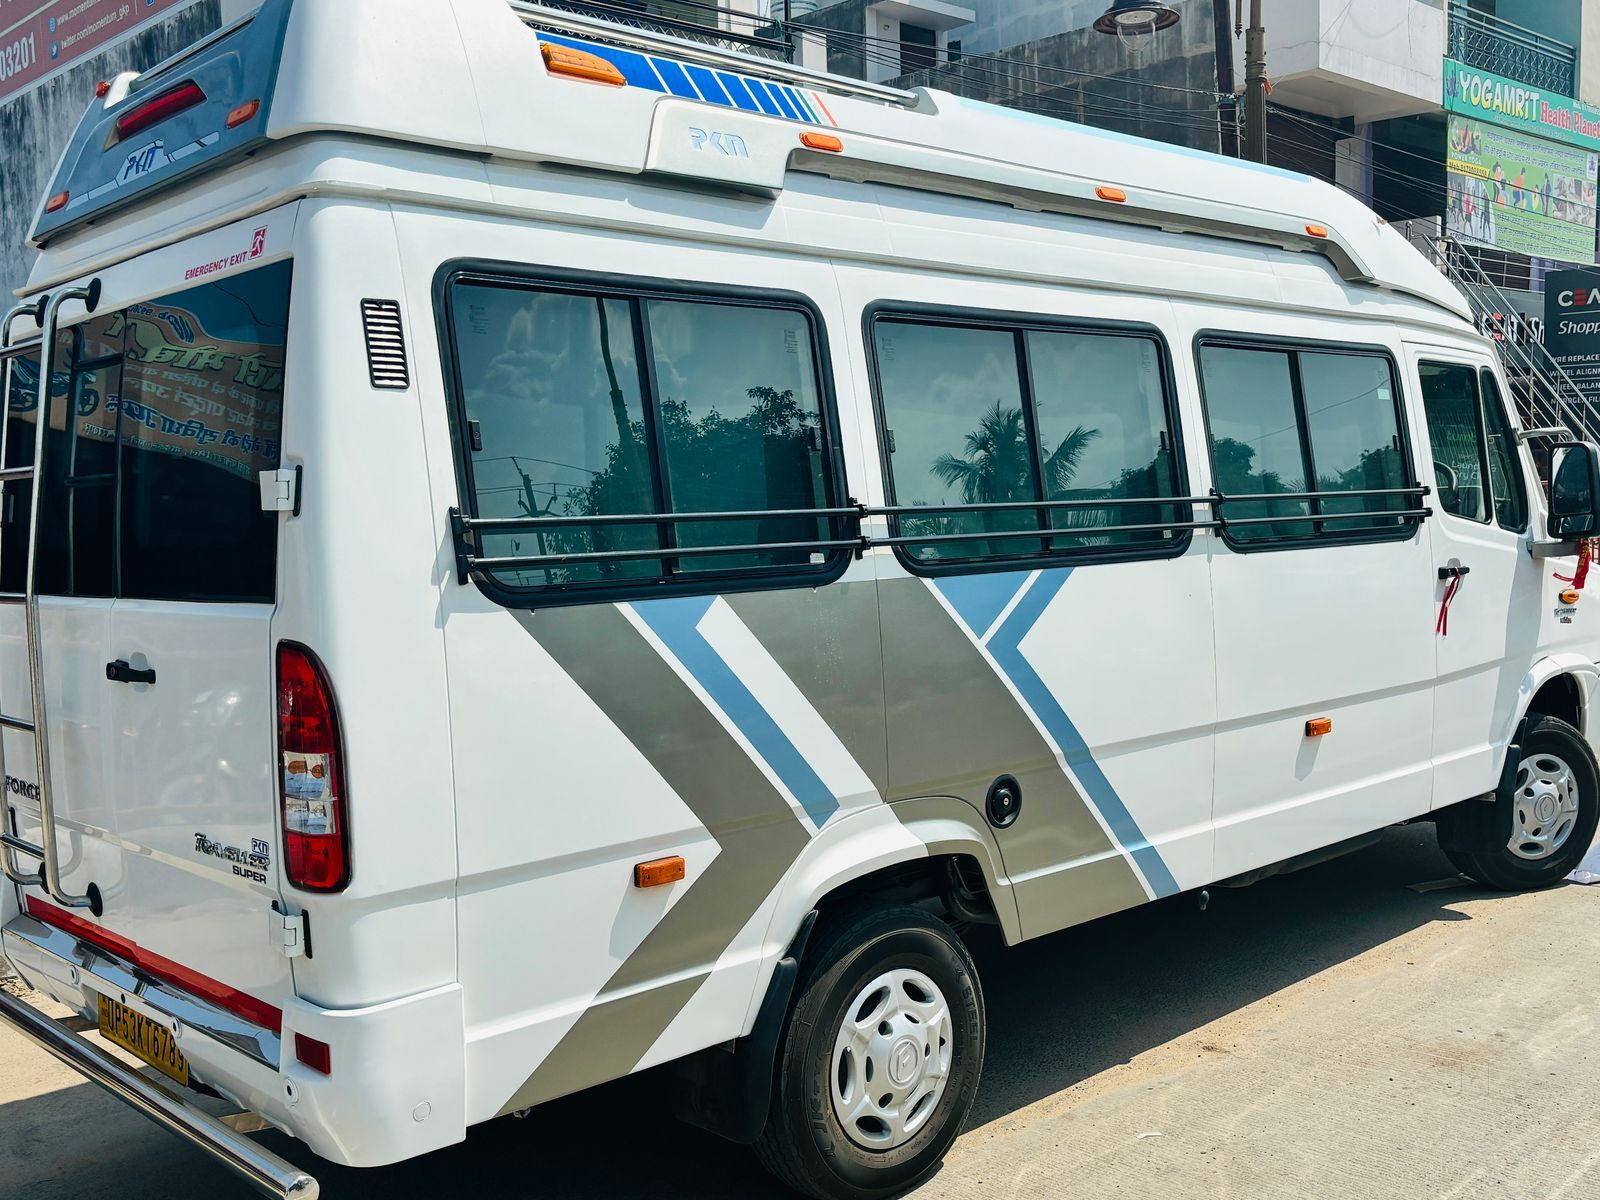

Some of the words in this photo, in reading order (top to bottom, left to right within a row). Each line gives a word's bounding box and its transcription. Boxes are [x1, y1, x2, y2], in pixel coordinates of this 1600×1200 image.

[1540, 101, 1571, 129] Health
[184, 257, 230, 281] EMERGENCY
[230, 250, 248, 267] EXIT
[1550, 355, 1567, 364] YRE
[6, 775, 41, 802] FORCE
[232, 864, 268, 885] SUPER
